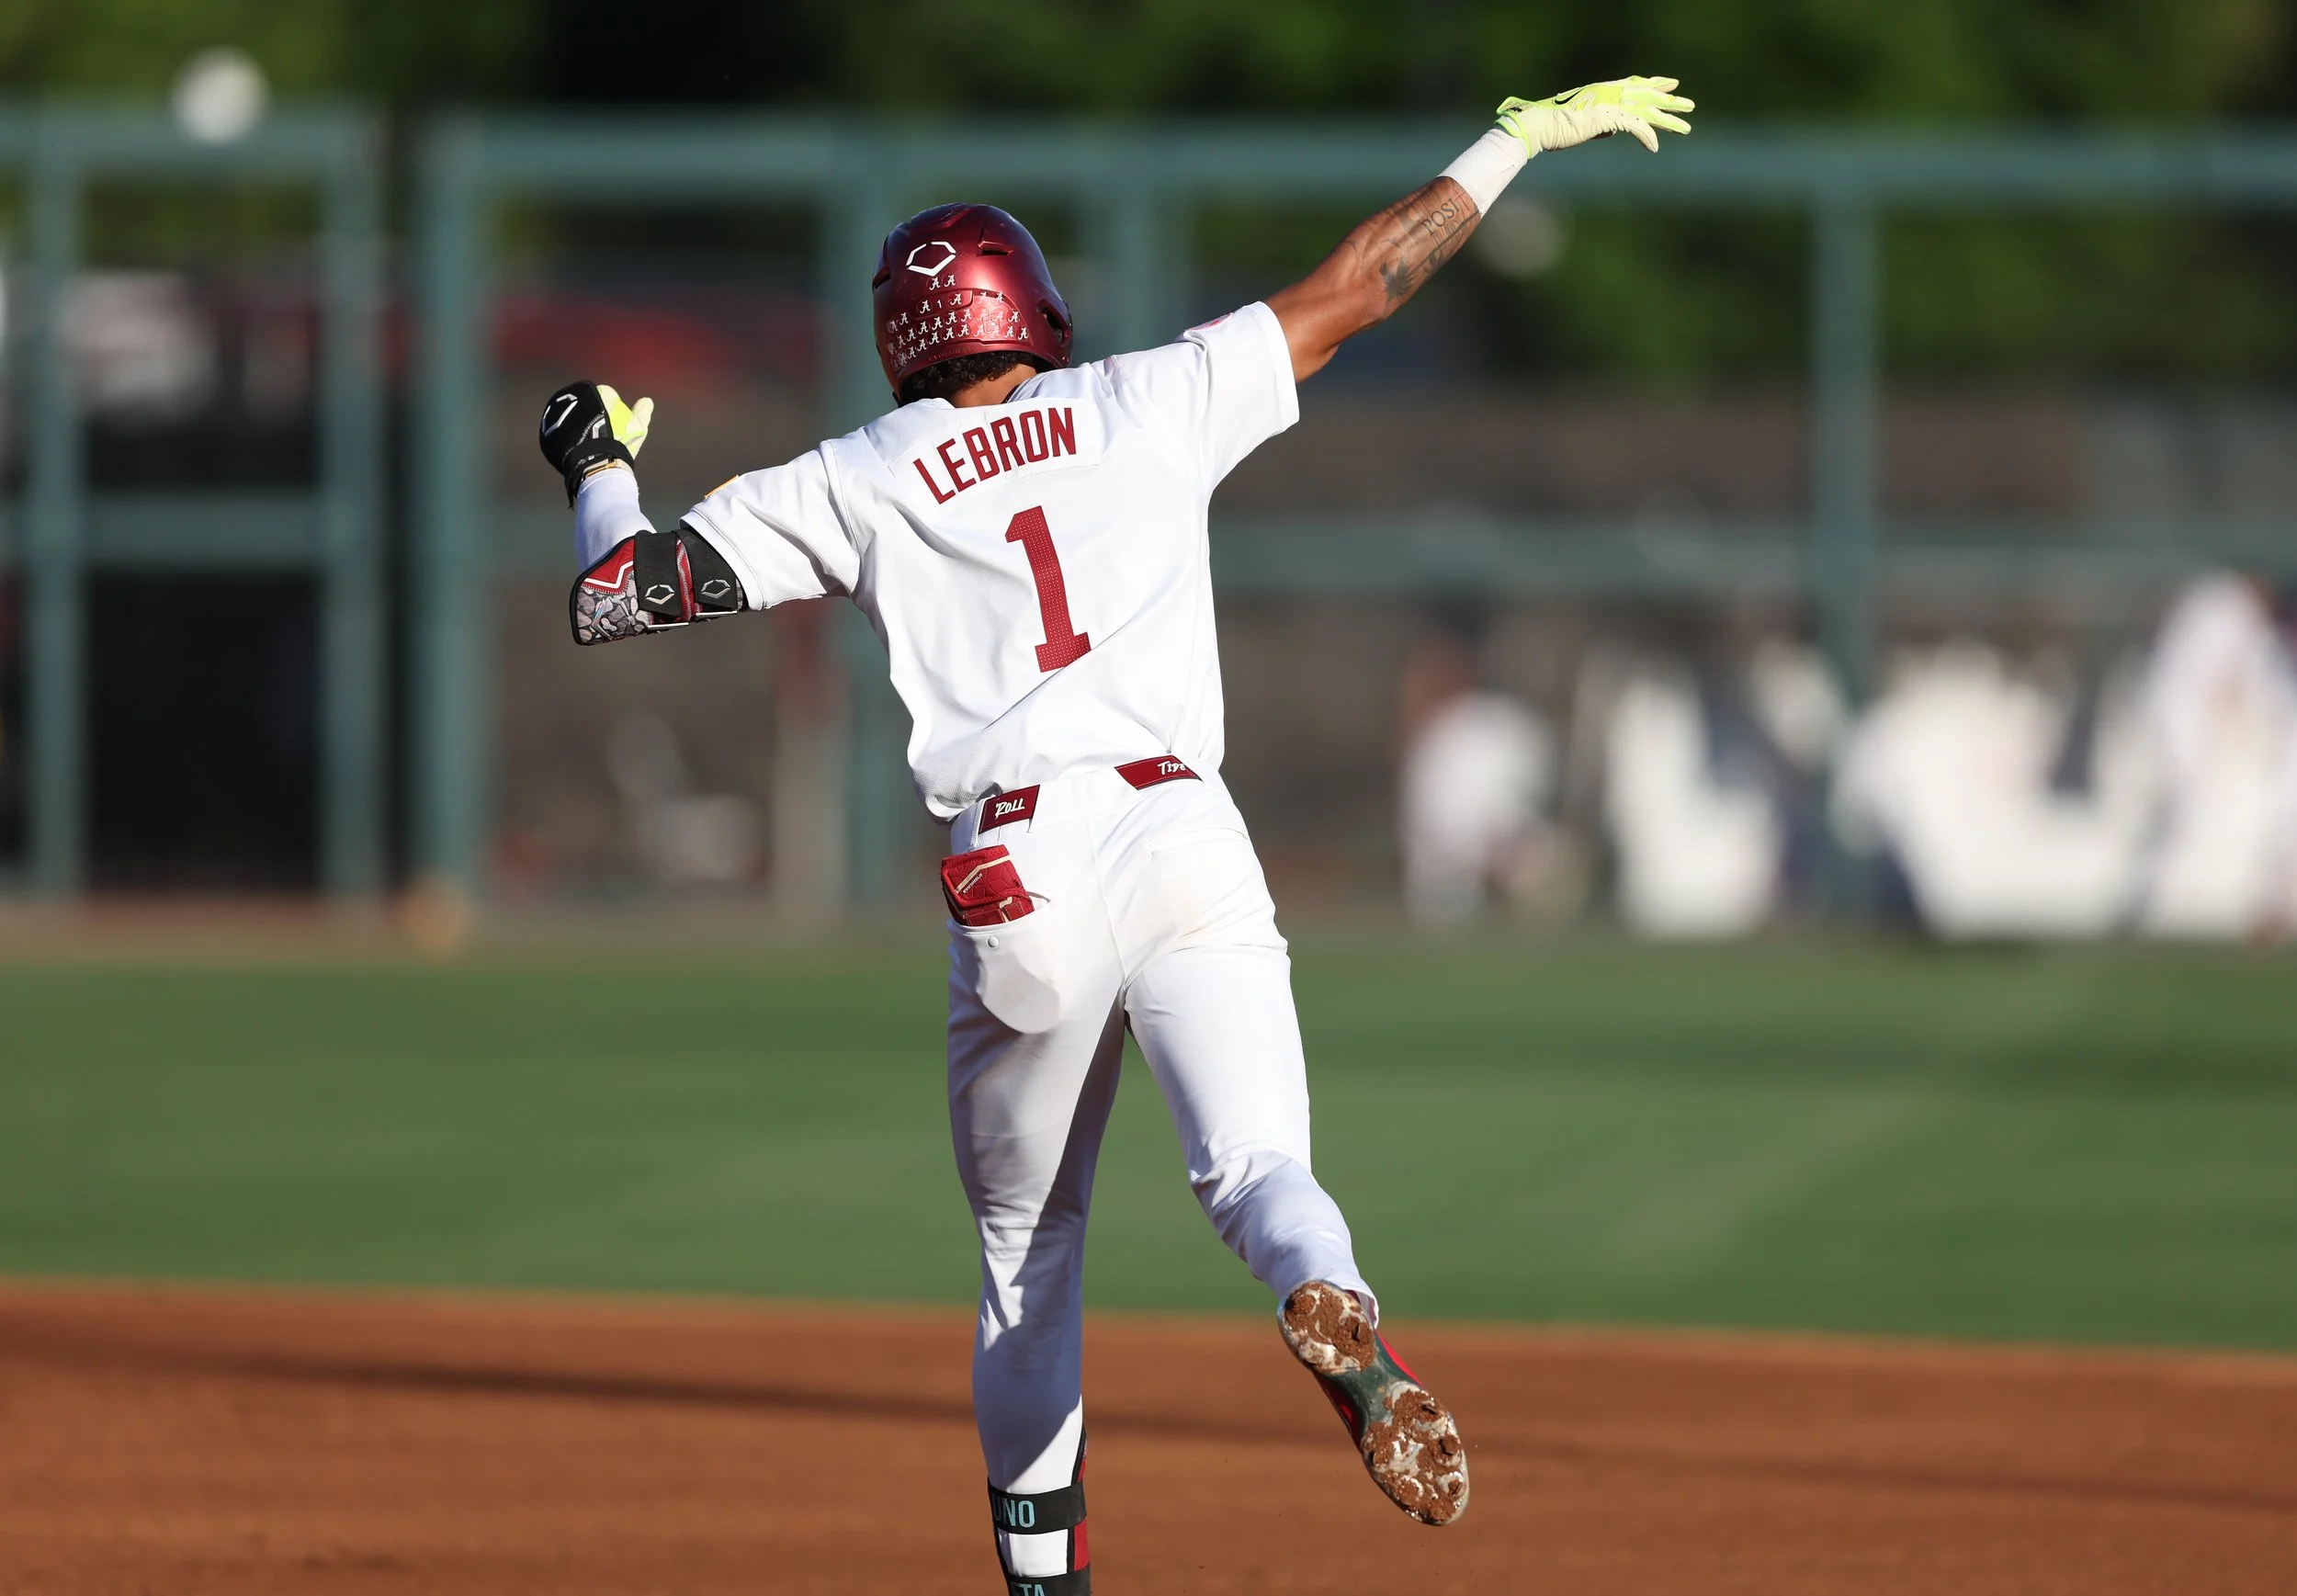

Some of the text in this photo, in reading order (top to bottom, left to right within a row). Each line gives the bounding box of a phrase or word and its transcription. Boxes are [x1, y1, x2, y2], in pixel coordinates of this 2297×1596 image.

[912, 407, 1077, 504] LEBRON
[1004, 504, 1092, 673] 1
[994, 798, 1026, 820] ROLL
